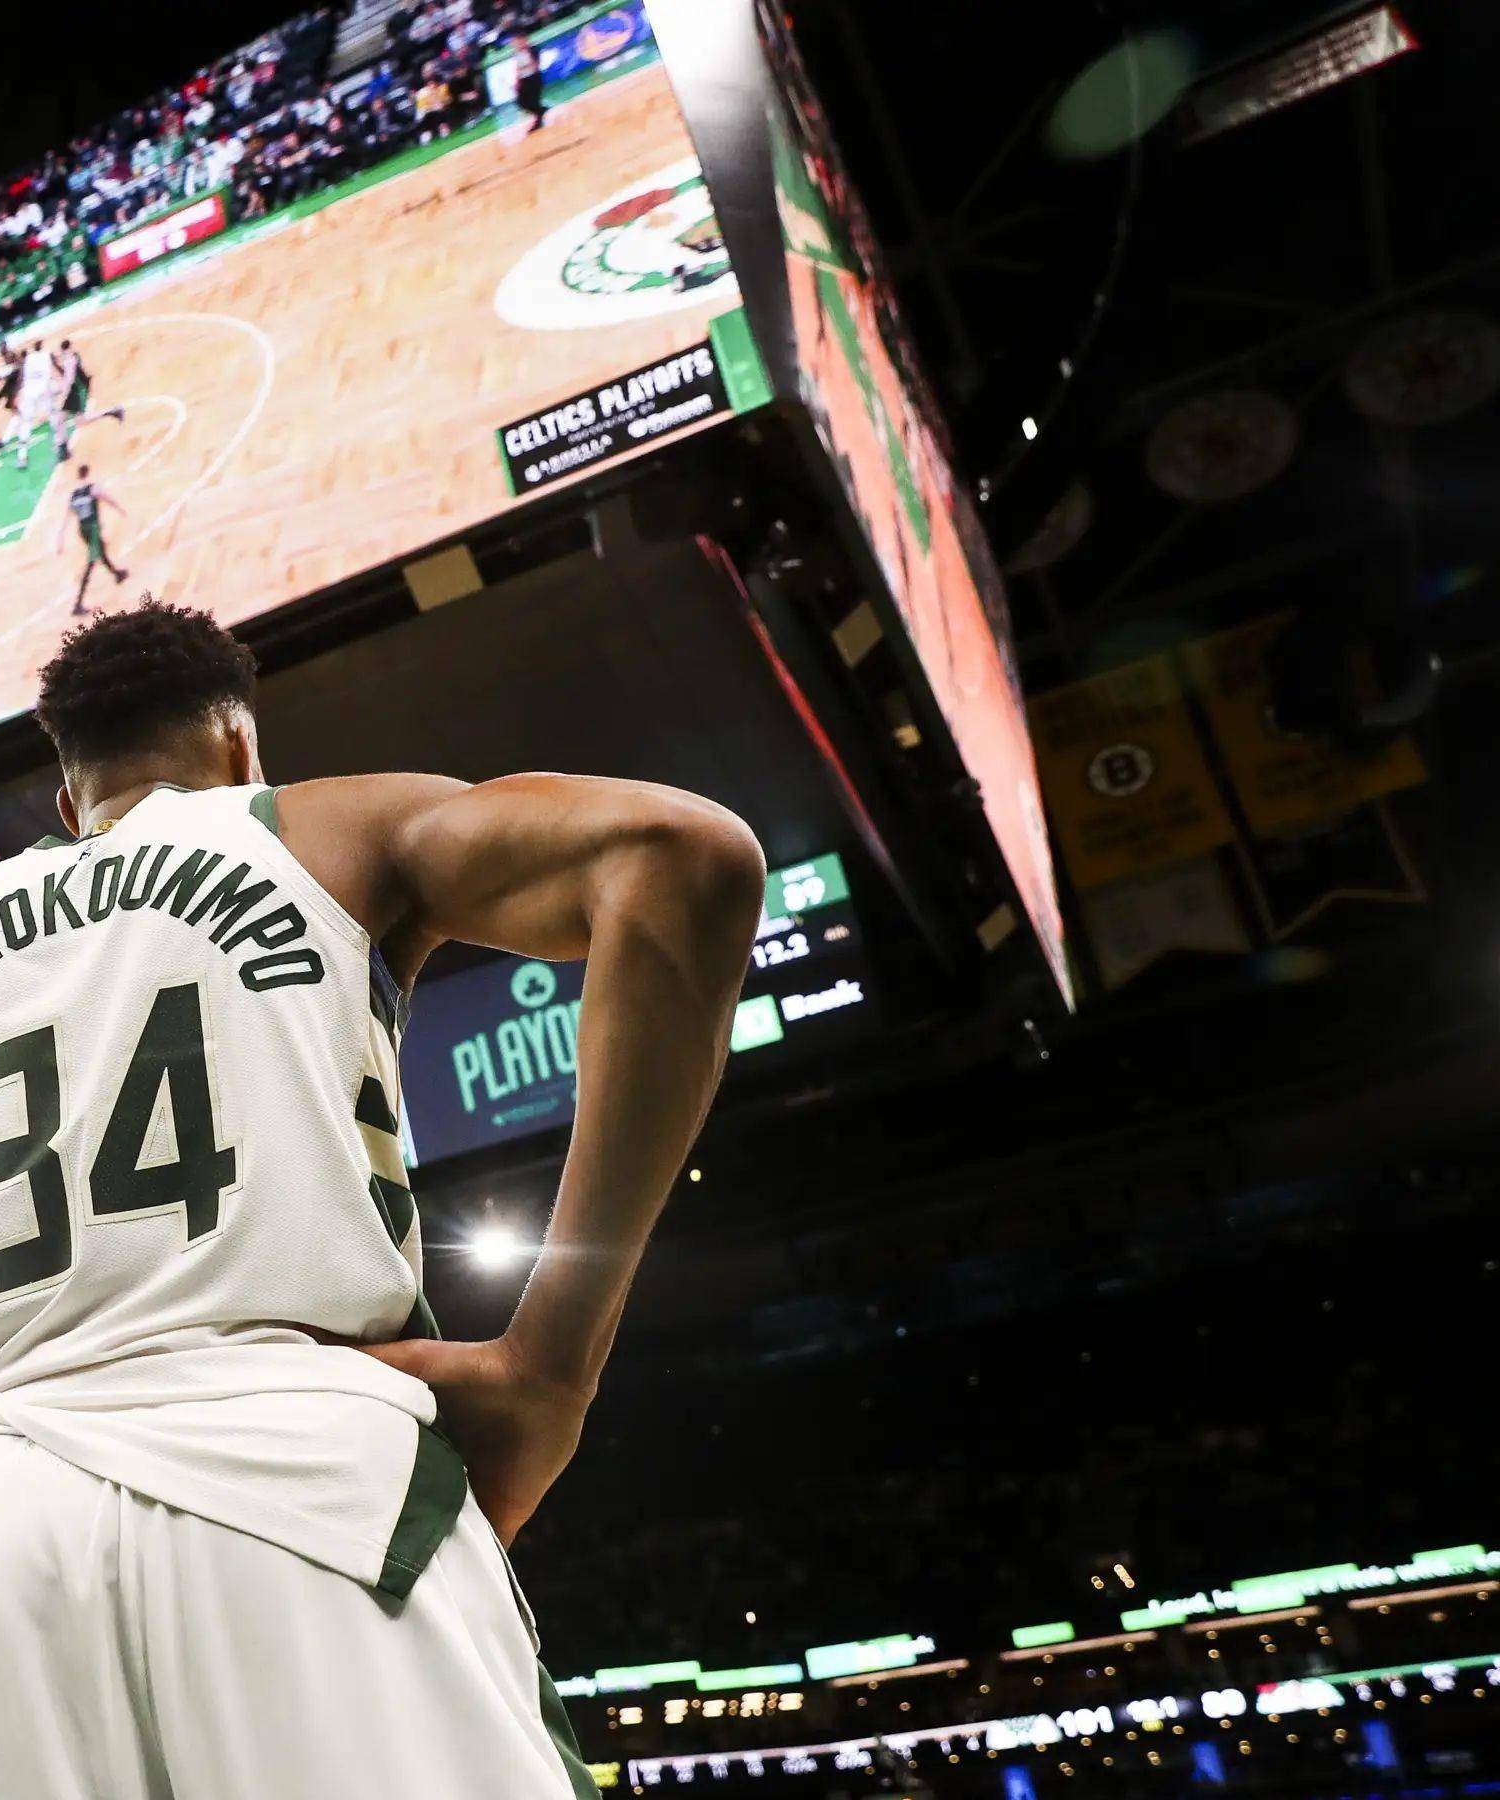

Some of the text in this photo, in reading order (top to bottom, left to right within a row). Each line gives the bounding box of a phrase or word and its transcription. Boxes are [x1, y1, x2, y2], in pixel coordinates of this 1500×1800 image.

[505, 398, 596, 457] CELTICS
[598, 348, 714, 417] PLAYOFFS
[782, 875, 826, 912] 89
[452, 1000, 584, 1113] PLAYO
